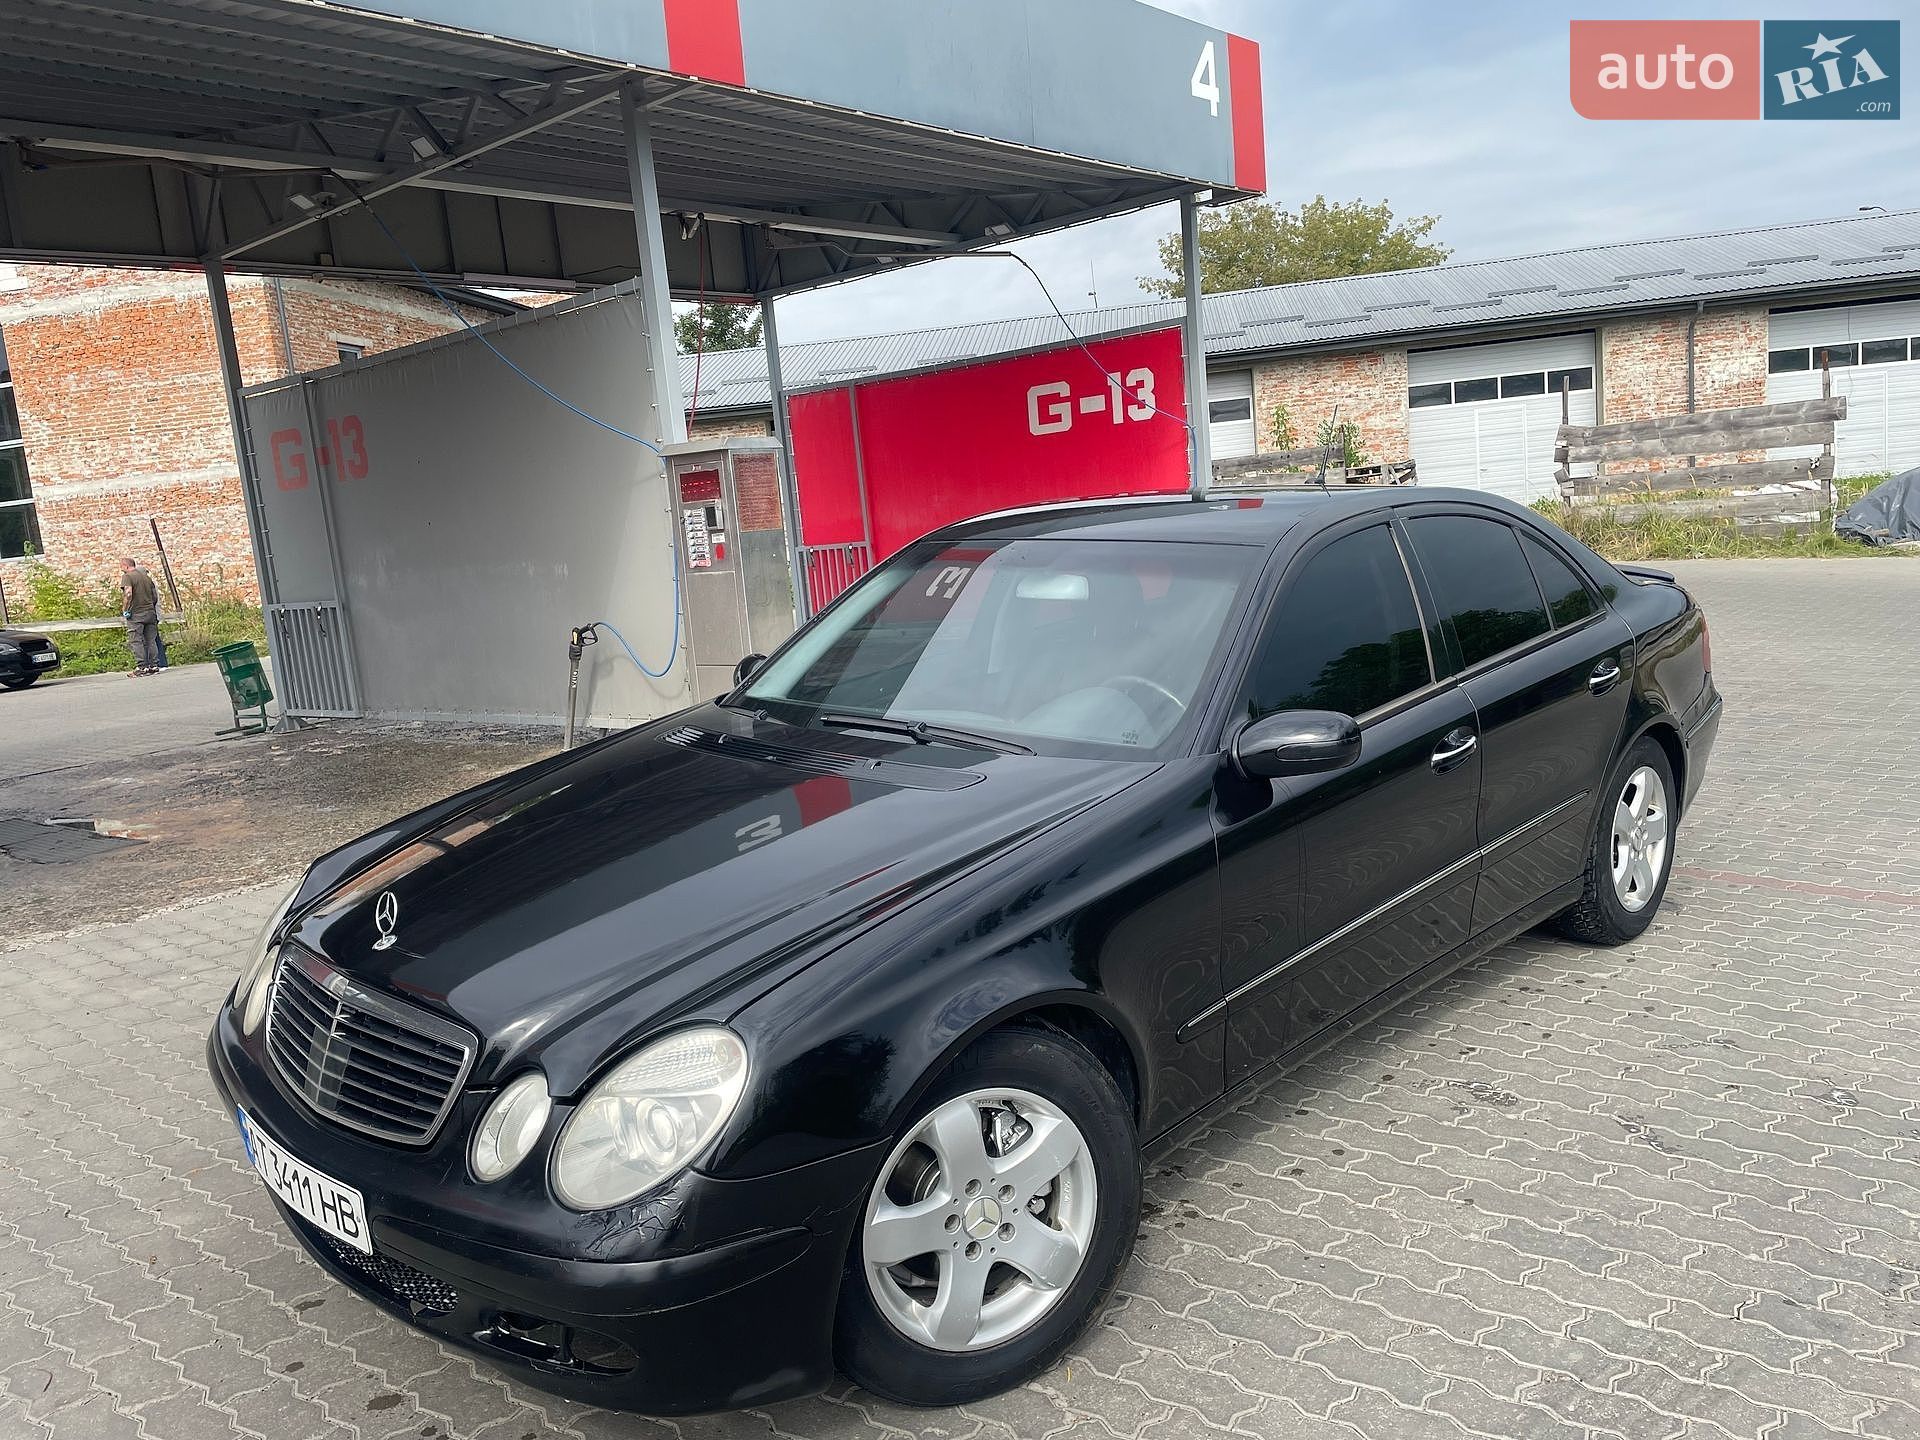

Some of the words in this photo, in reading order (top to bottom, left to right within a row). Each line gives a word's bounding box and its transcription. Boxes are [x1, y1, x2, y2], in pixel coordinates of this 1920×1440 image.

[1191, 40, 1220, 117] 4
[1027, 367, 1156, 436] G-13
[270, 415, 369, 491] G-13
[269, 1149, 315, 1217] 3411
[317, 1182, 359, 1239] HB
